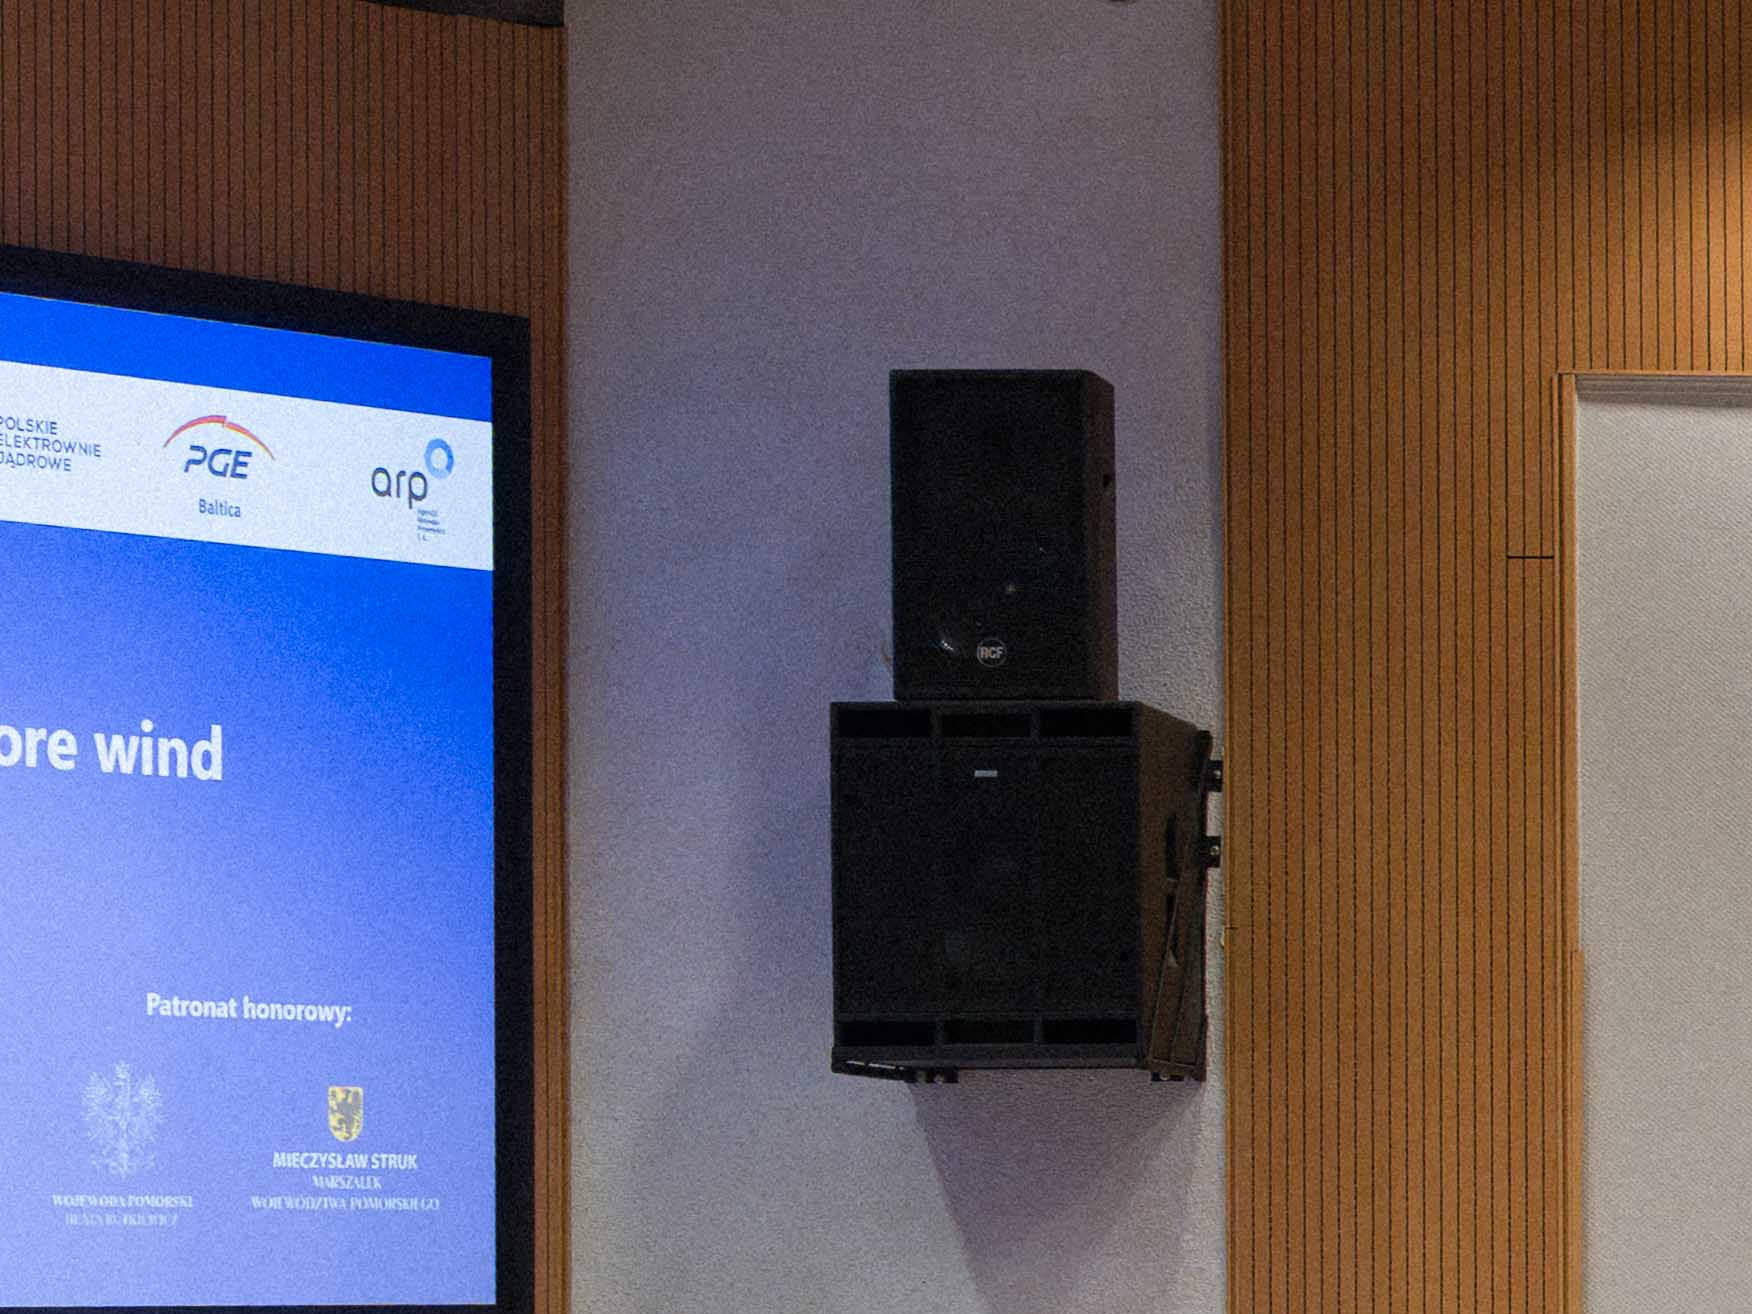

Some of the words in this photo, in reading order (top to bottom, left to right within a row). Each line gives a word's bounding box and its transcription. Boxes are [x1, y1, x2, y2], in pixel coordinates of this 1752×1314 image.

[183, 445, 253, 479] PGE
[371, 467, 428, 510] arp
[198, 498, 242, 518] Baltica
[94, 719, 223, 781] wind
[146, 992, 238, 1019] Patronat
[242, 996, 353, 1028] honorowy:
[371, 1153, 418, 1170] STRUK
